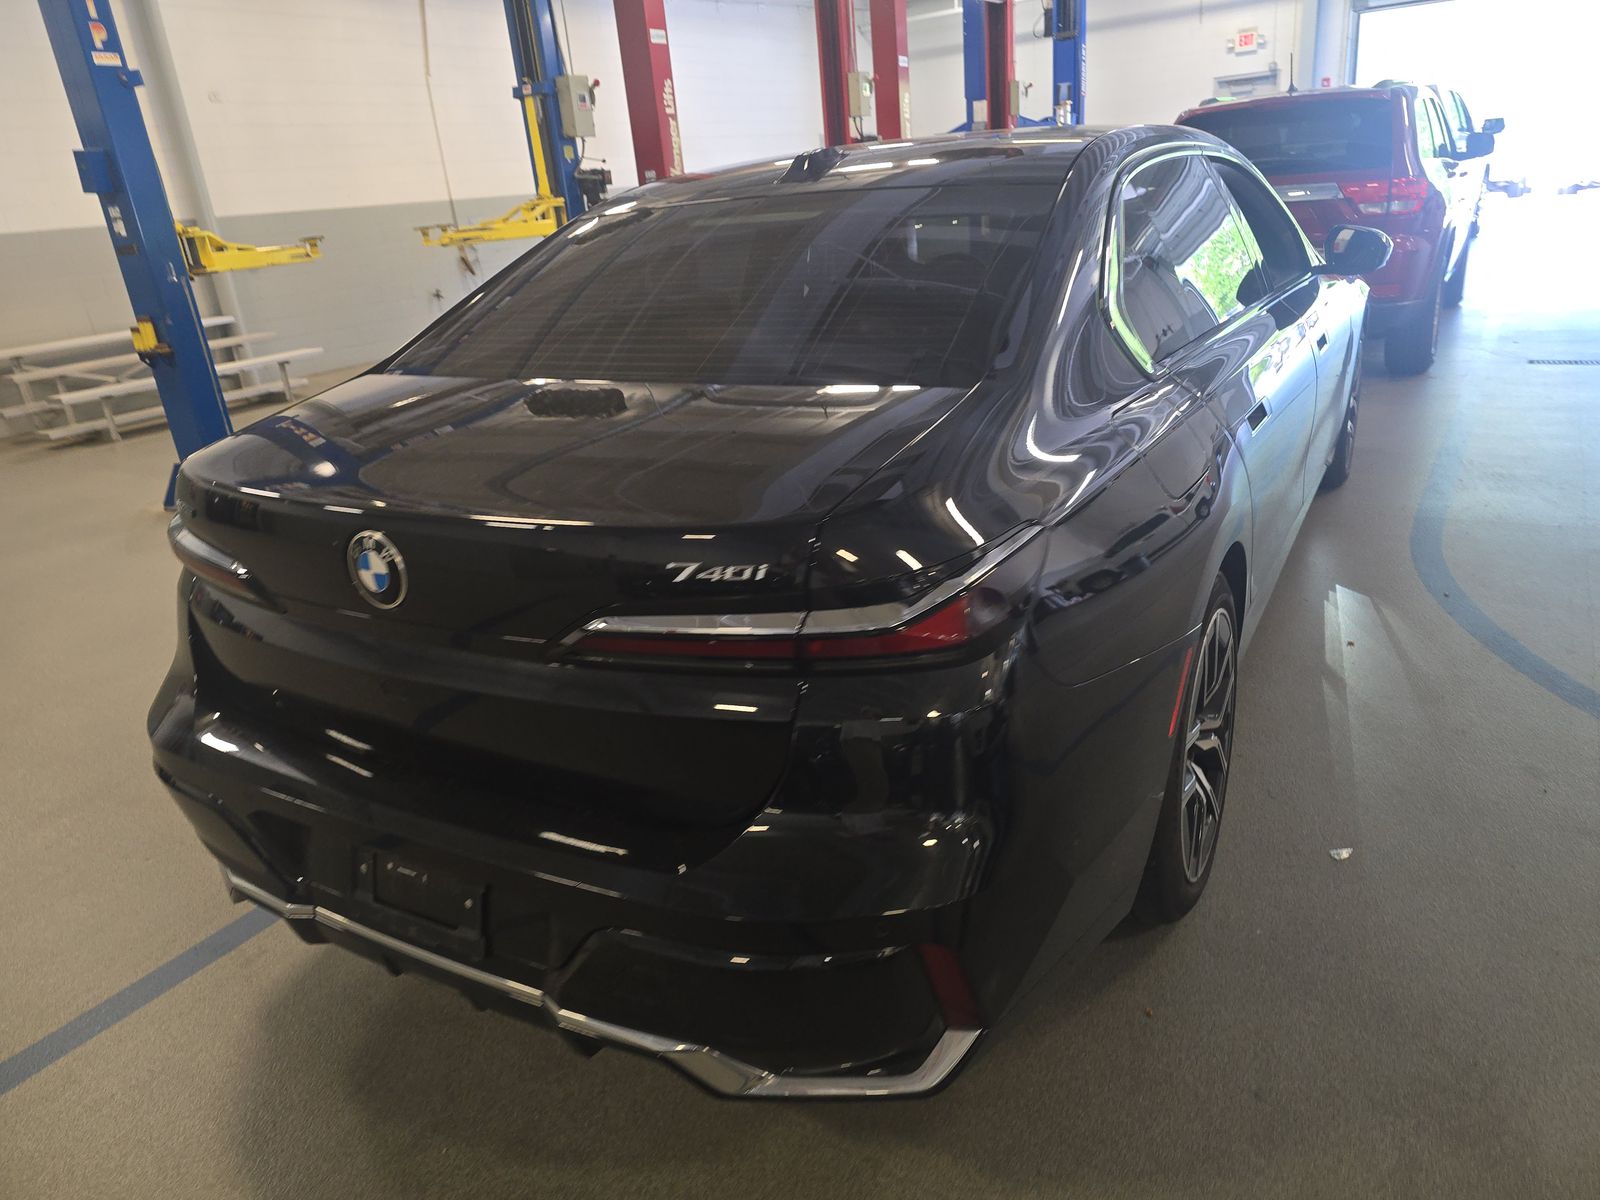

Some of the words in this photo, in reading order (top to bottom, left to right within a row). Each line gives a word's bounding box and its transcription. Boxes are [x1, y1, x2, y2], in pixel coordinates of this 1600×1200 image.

[663, 78, 675, 114] Lifts
[352, 535, 397, 562] BMW
[665, 561, 769, 582] 740i
